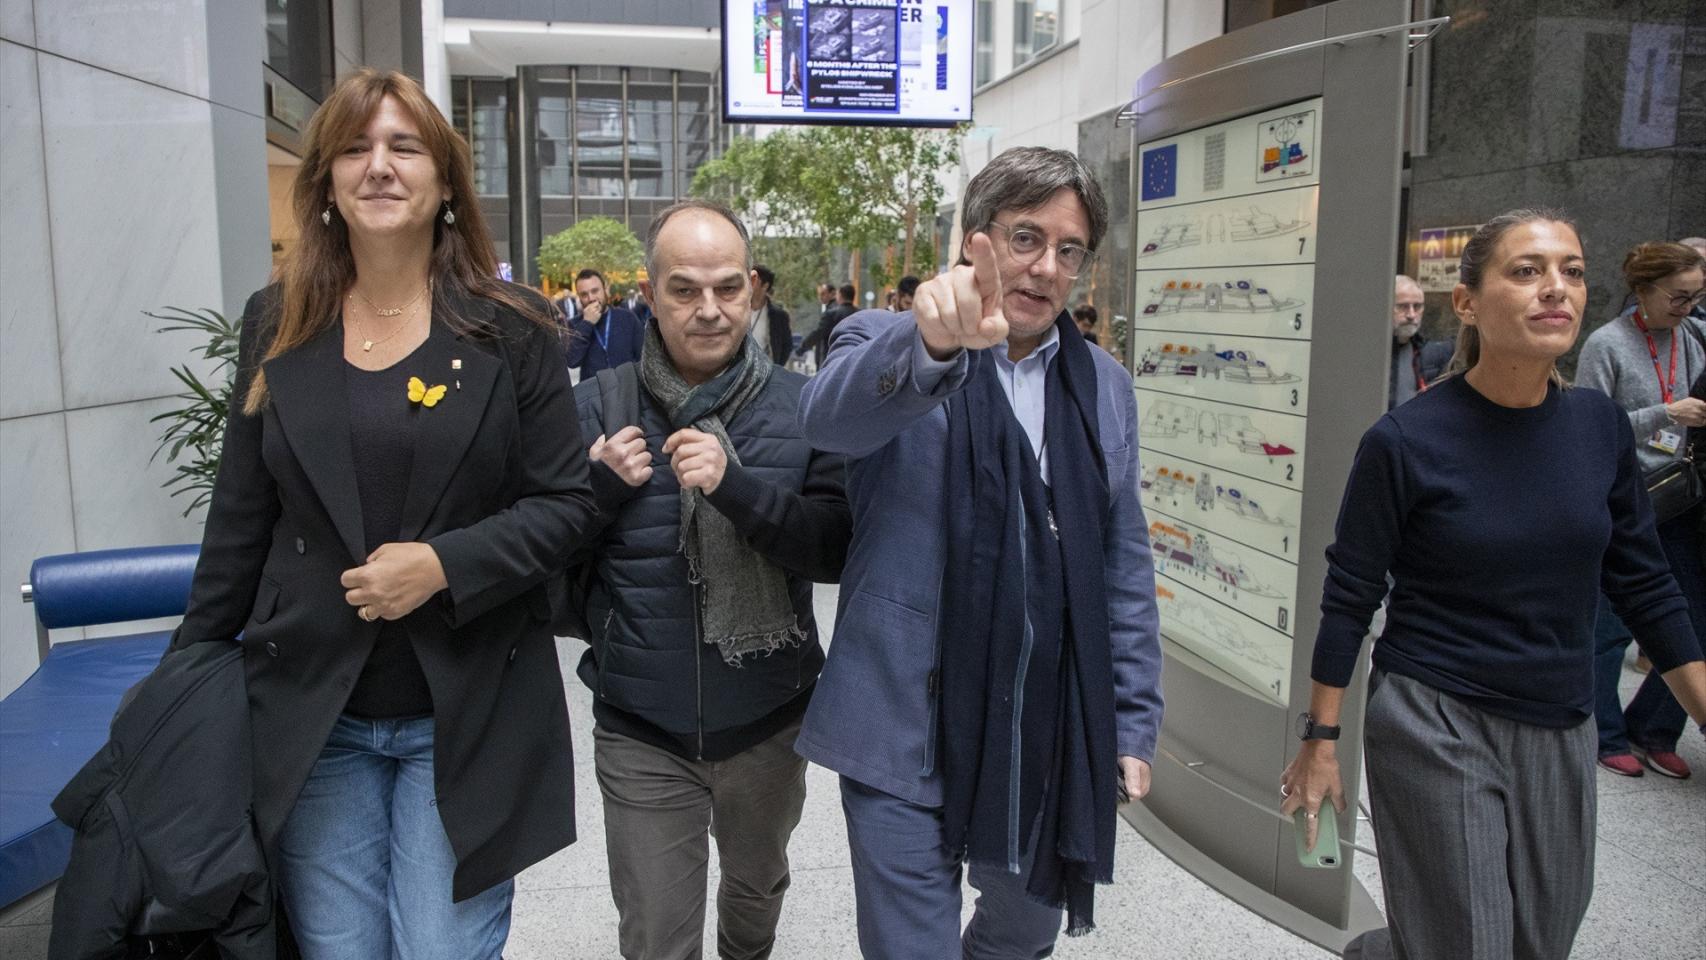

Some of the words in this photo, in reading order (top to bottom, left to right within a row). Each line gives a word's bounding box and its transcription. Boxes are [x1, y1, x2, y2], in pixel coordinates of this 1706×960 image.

[813, 61, 851, 69] MONTHS
[841, 70, 893, 78] SHIPWRECK
[1298, 237, 1306, 255] 7
[1293, 313, 1302, 331] 5
[1290, 389, 1299, 407] 3
[1286, 463, 1294, 481] 2
[1282, 536, 1289, 553] 1
